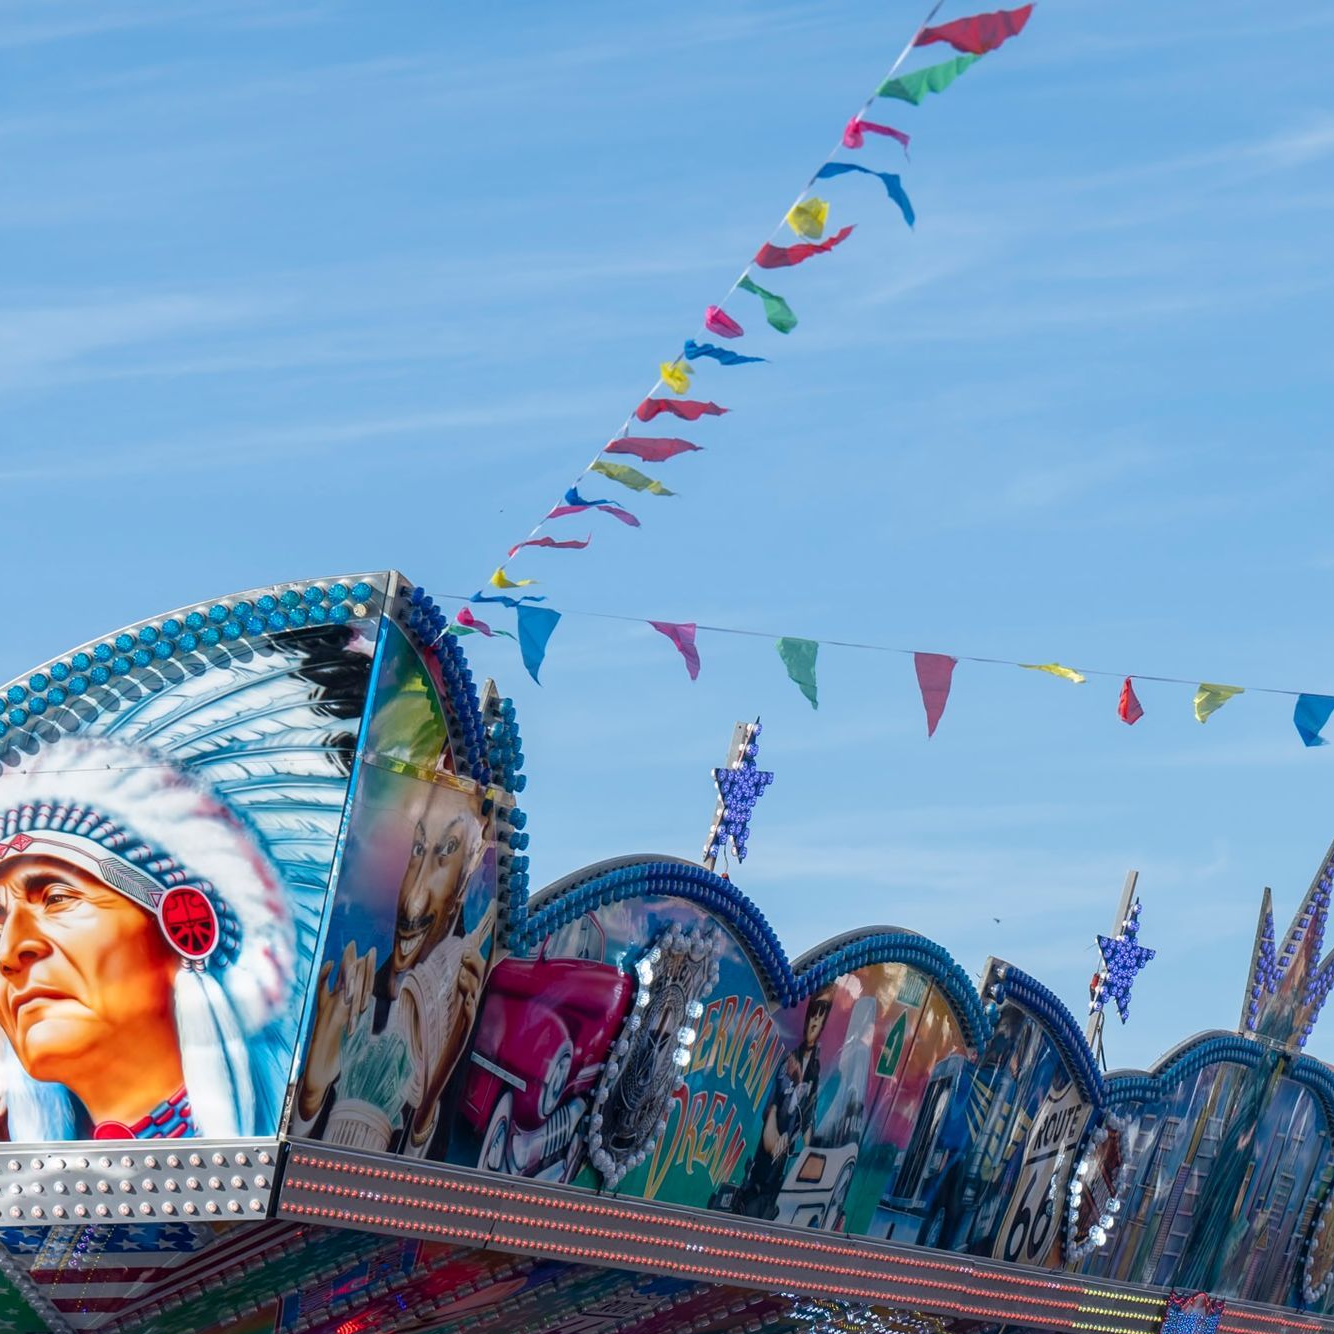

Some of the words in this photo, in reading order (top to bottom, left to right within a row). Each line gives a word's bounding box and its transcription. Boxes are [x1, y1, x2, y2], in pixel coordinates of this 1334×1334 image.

[683, 995, 785, 1113] ERICAN
[644, 1084, 746, 1199] DREAM
[1033, 1104, 1082, 1151] ROUTE
[1003, 1169, 1056, 1261] 66
